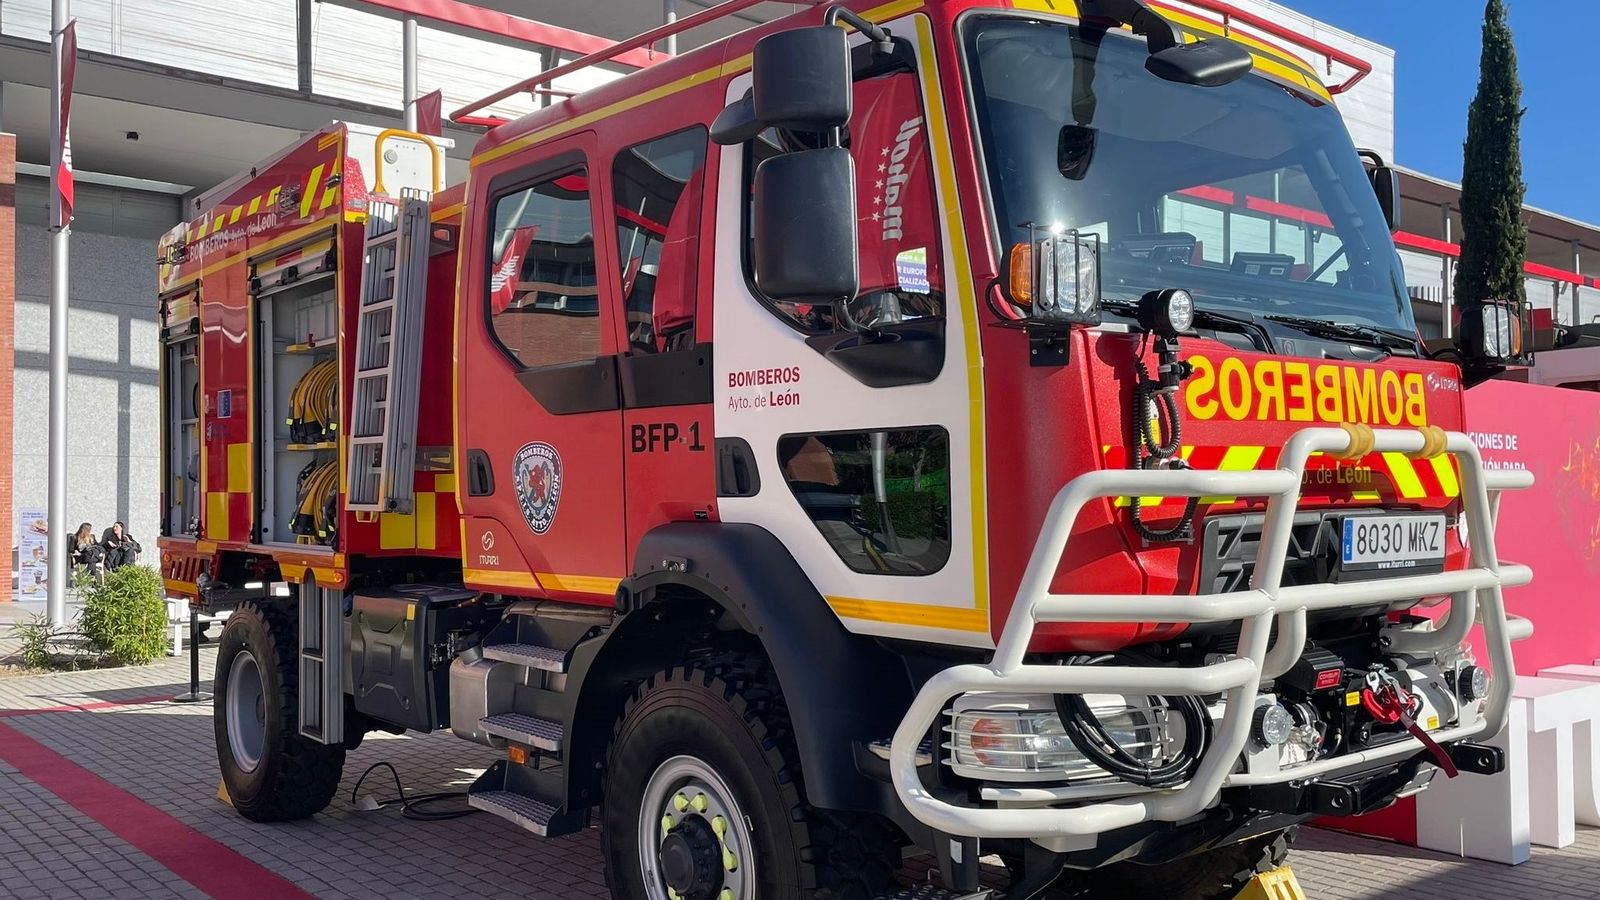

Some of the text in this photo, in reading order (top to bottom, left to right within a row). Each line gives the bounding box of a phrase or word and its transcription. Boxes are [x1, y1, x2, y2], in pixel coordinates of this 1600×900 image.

[728, 366, 800, 388] BOMBEROS
[728, 388, 800, 413] Ayto. de León
[1505, 434, 1518, 450] DE
[1316, 463, 1333, 484] de
[1336, 459, 1372, 484] León
[1357, 523, 1403, 555] 8030
[1408, 521, 1440, 553] MKZ
